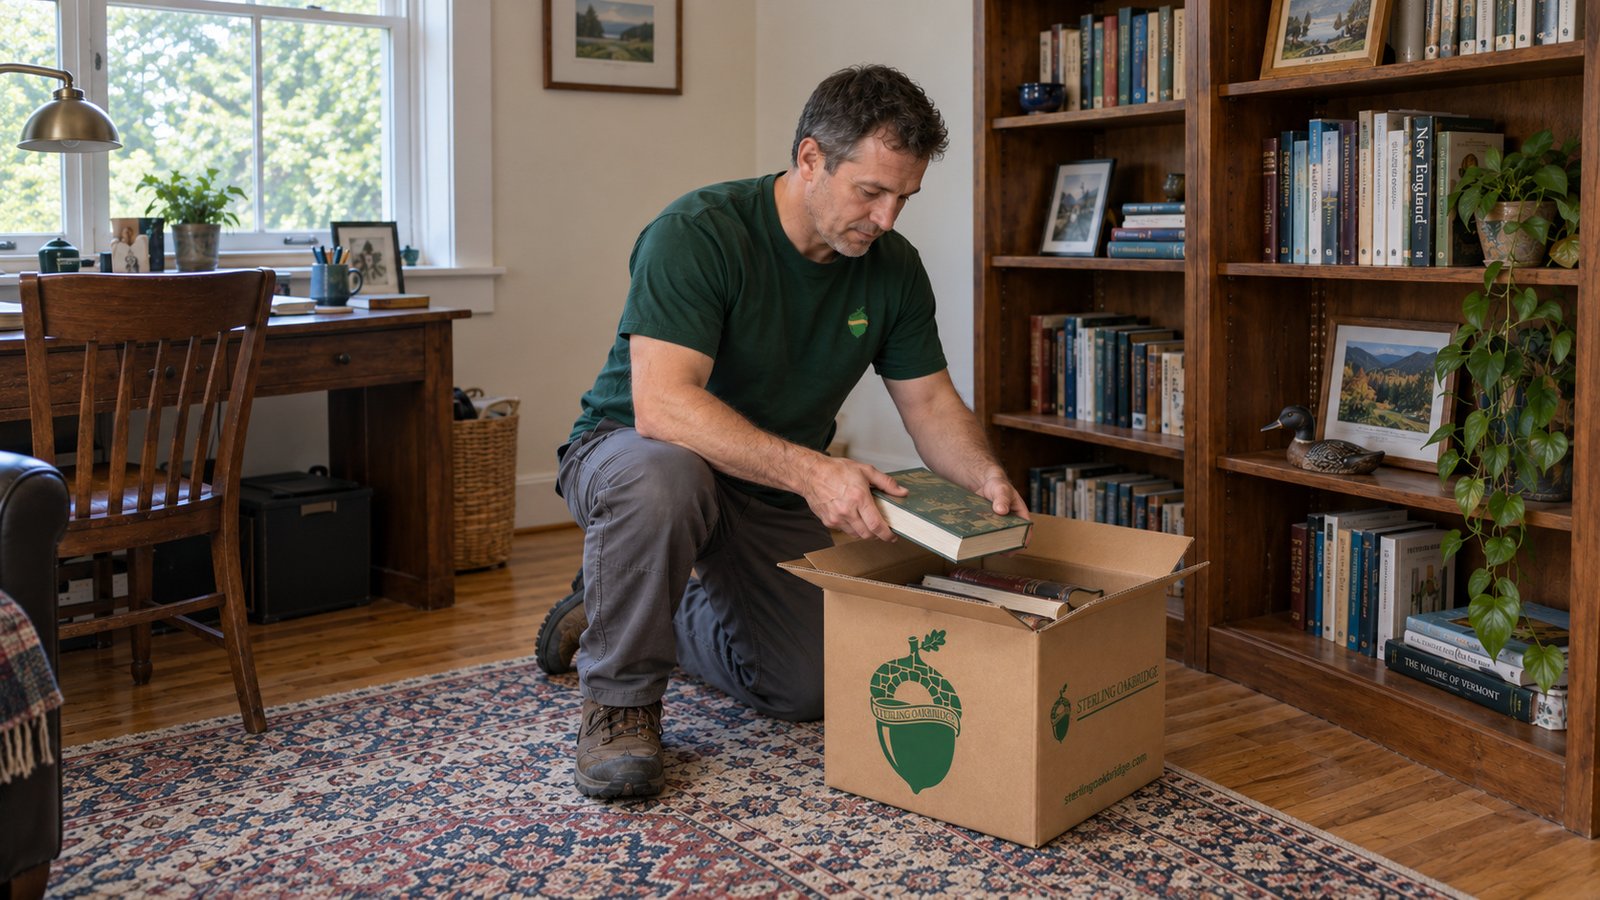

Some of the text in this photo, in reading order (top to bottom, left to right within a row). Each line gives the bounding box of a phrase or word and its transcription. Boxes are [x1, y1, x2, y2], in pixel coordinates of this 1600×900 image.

[1415, 126, 1428, 224] New England
[1077, 665, 1159, 713] STERLING OAKBRIDGE
[1404, 656, 1500, 700] THE NATURE OF VERMONT
